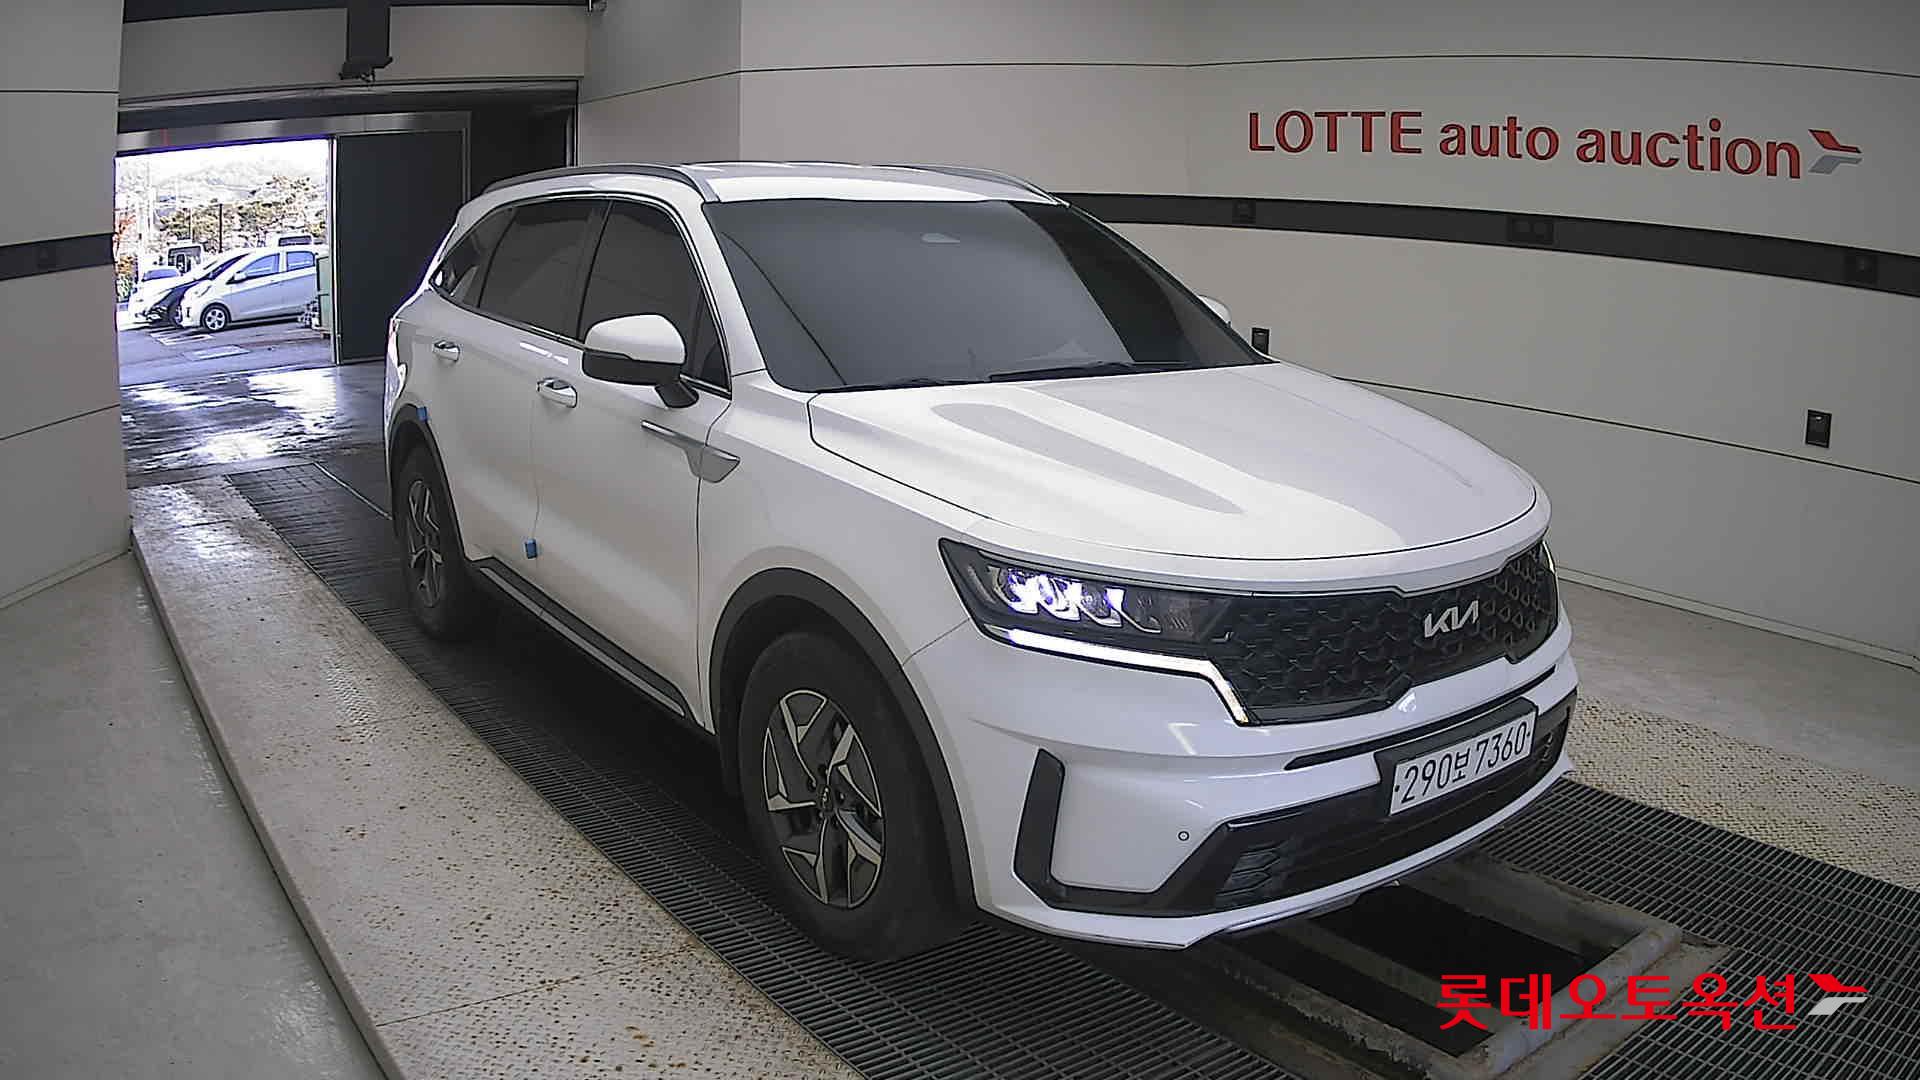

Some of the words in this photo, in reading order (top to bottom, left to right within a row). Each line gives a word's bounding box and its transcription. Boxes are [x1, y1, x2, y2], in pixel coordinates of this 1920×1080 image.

[1249, 110, 1423, 154] LOTTE
[1439, 116, 1560, 161] auto
[1576, 117, 1801, 179] auction
